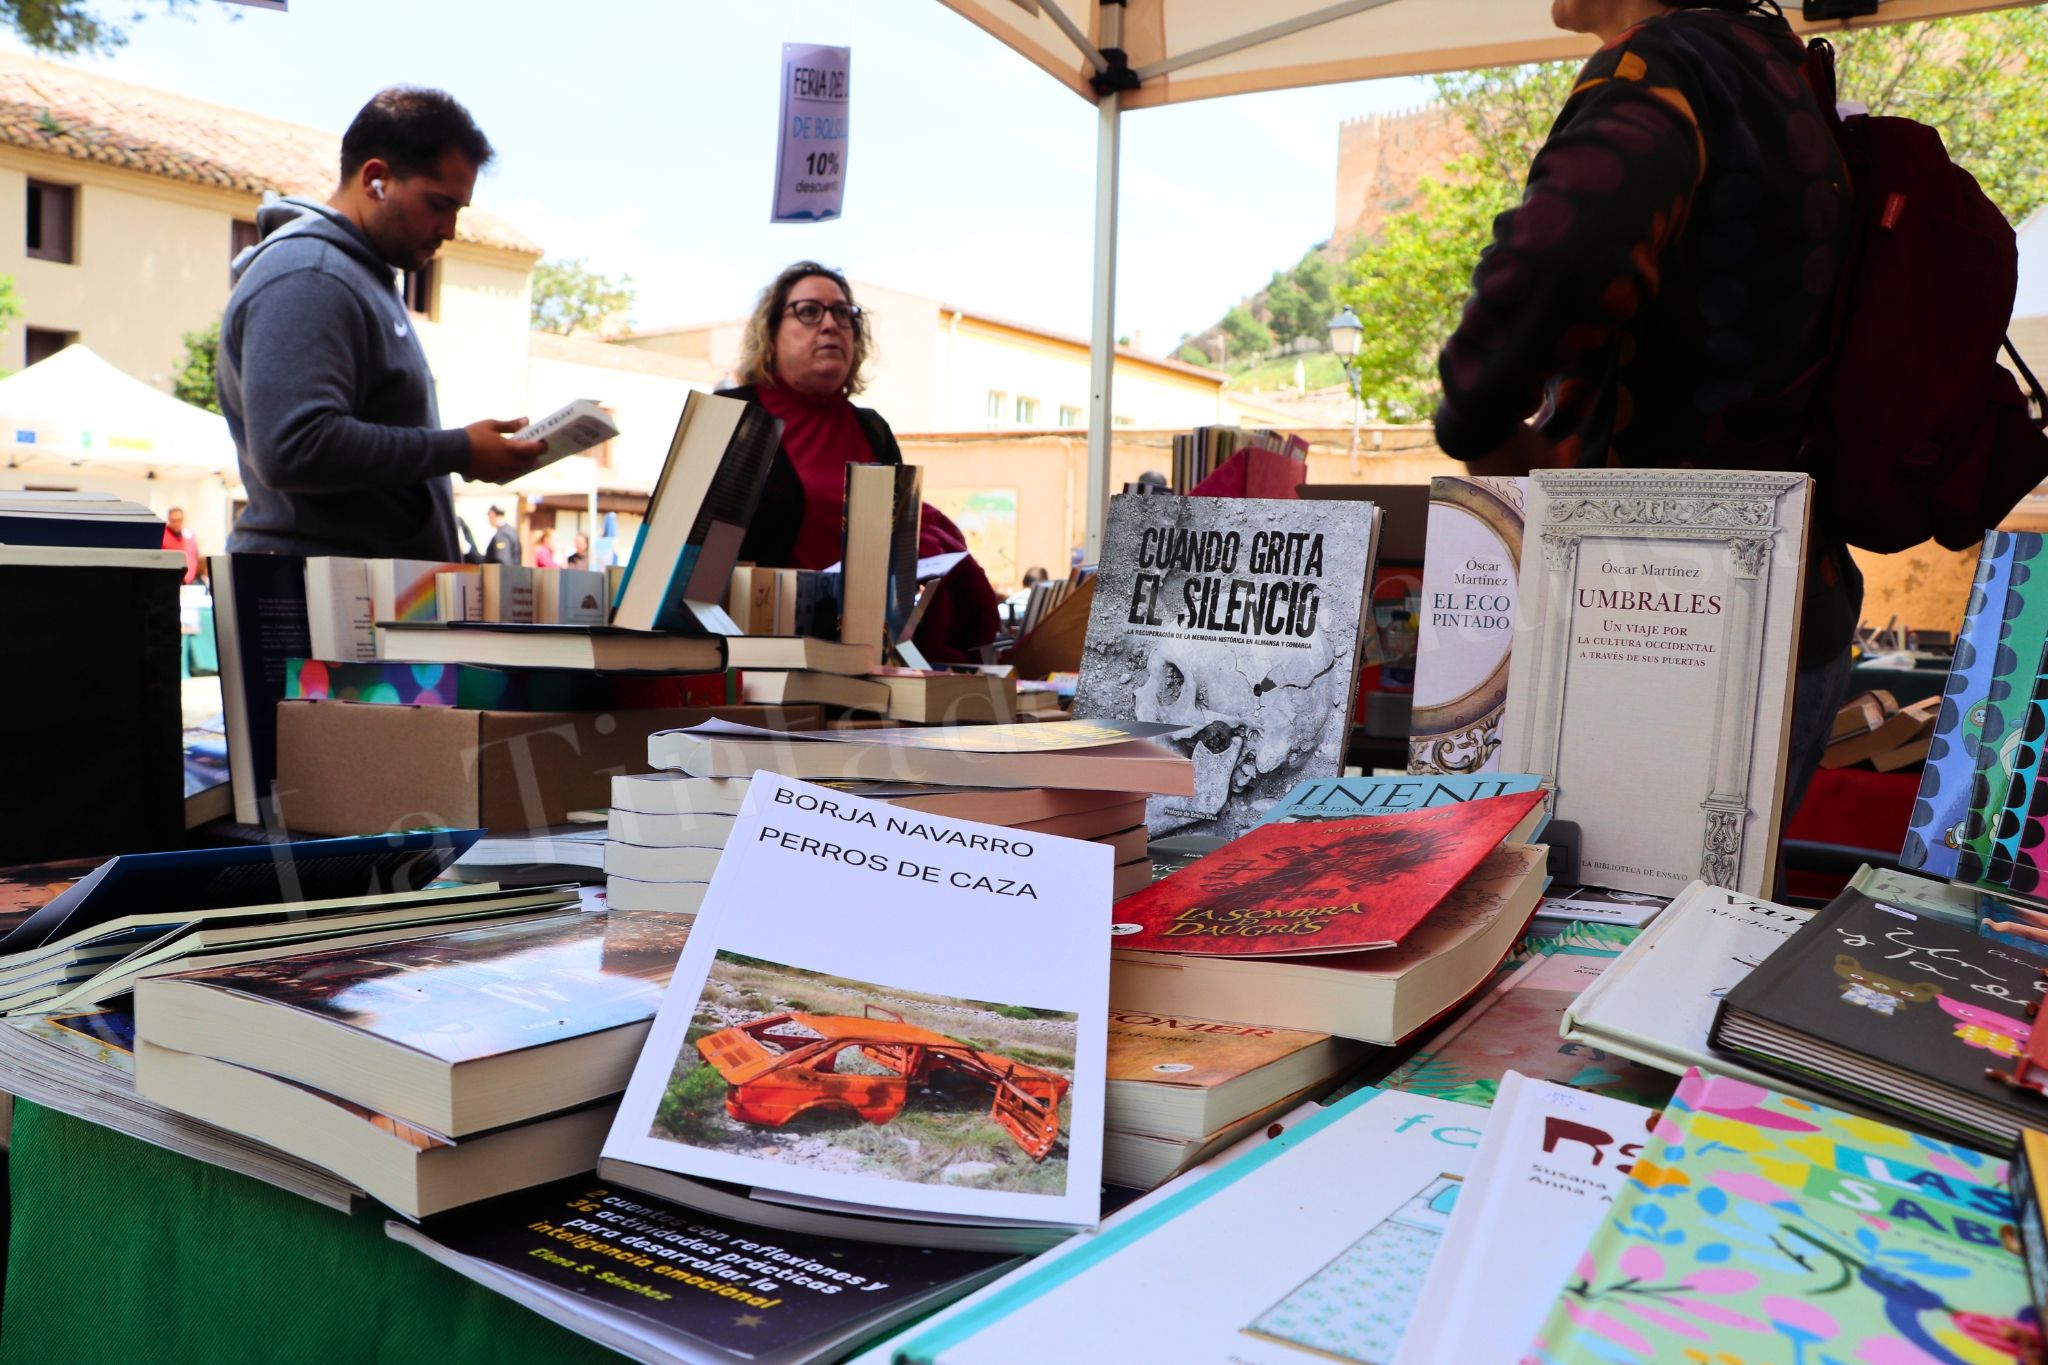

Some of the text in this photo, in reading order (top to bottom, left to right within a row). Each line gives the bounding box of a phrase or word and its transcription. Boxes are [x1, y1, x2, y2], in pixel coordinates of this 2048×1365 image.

[794, 67, 826, 96] FERIA
[806, 151, 839, 175] 10%
[1138, 527, 1325, 577] CUANDO GRITA
[1466, 556, 1501, 571] Óscar
[1601, 559, 1700, 578] Óscar Martínez
[1454, 573, 1508, 586] Martínez
[1127, 573, 1319, 638] EL SILENCIO
[1433, 593, 1511, 612] EL ECO
[1578, 588, 1721, 615] UMBRALES
[1432, 613, 1510, 629] PINTADO
[1626, 624, 1659, 637] VIAJE
[1663, 626, 1688, 636] POR
[1135, 629, 1175, 639] RECUPERACIÓN
[1175, 632, 1183, 640] DE
[1191, 634, 1217, 642] MEMORIA
[1218, 635, 1245, 644] HISTÓRICA
[1254, 639, 1280, 647] ALMANSA
[1285, 641, 1312, 649] COMARCA
[1578, 636, 1716, 653] LA CULTURA OCCIDENTAL
[1589, 651, 1623, 661] TRAVÉS
[1626, 654, 1639, 662] DE
[1642, 655, 1659, 663] SUS
[1662, 656, 1706, 667] PUERTAS
[1304, 805, 1374, 813] SOLDADO
[773, 787, 1034, 858] BORJA NAVARRO
[759, 826, 1038, 900] PERROS DE CAZA
[1582, 860, 1688, 881] LA BIBLIOTECA DE ENSAYO
[1173, 902, 1364, 921] LA SOMBRA
[1529, 1175, 1585, 1196] Anna
[1532, 1164, 1607, 1190] Susana
[1863, 1154, 2018, 1221] LAS
[566, 1198, 843, 1295] 36 actividades prácticas
[602, 1195, 687, 1228] cuentos
[687, 1223, 730, 1241] con
[729, 1238, 867, 1286] reflexiones
[860, 1280, 889, 1292] y
[528, 1219, 783, 1310] inteligencia emocional
[562, 1217, 780, 1293] para desarrollar la
